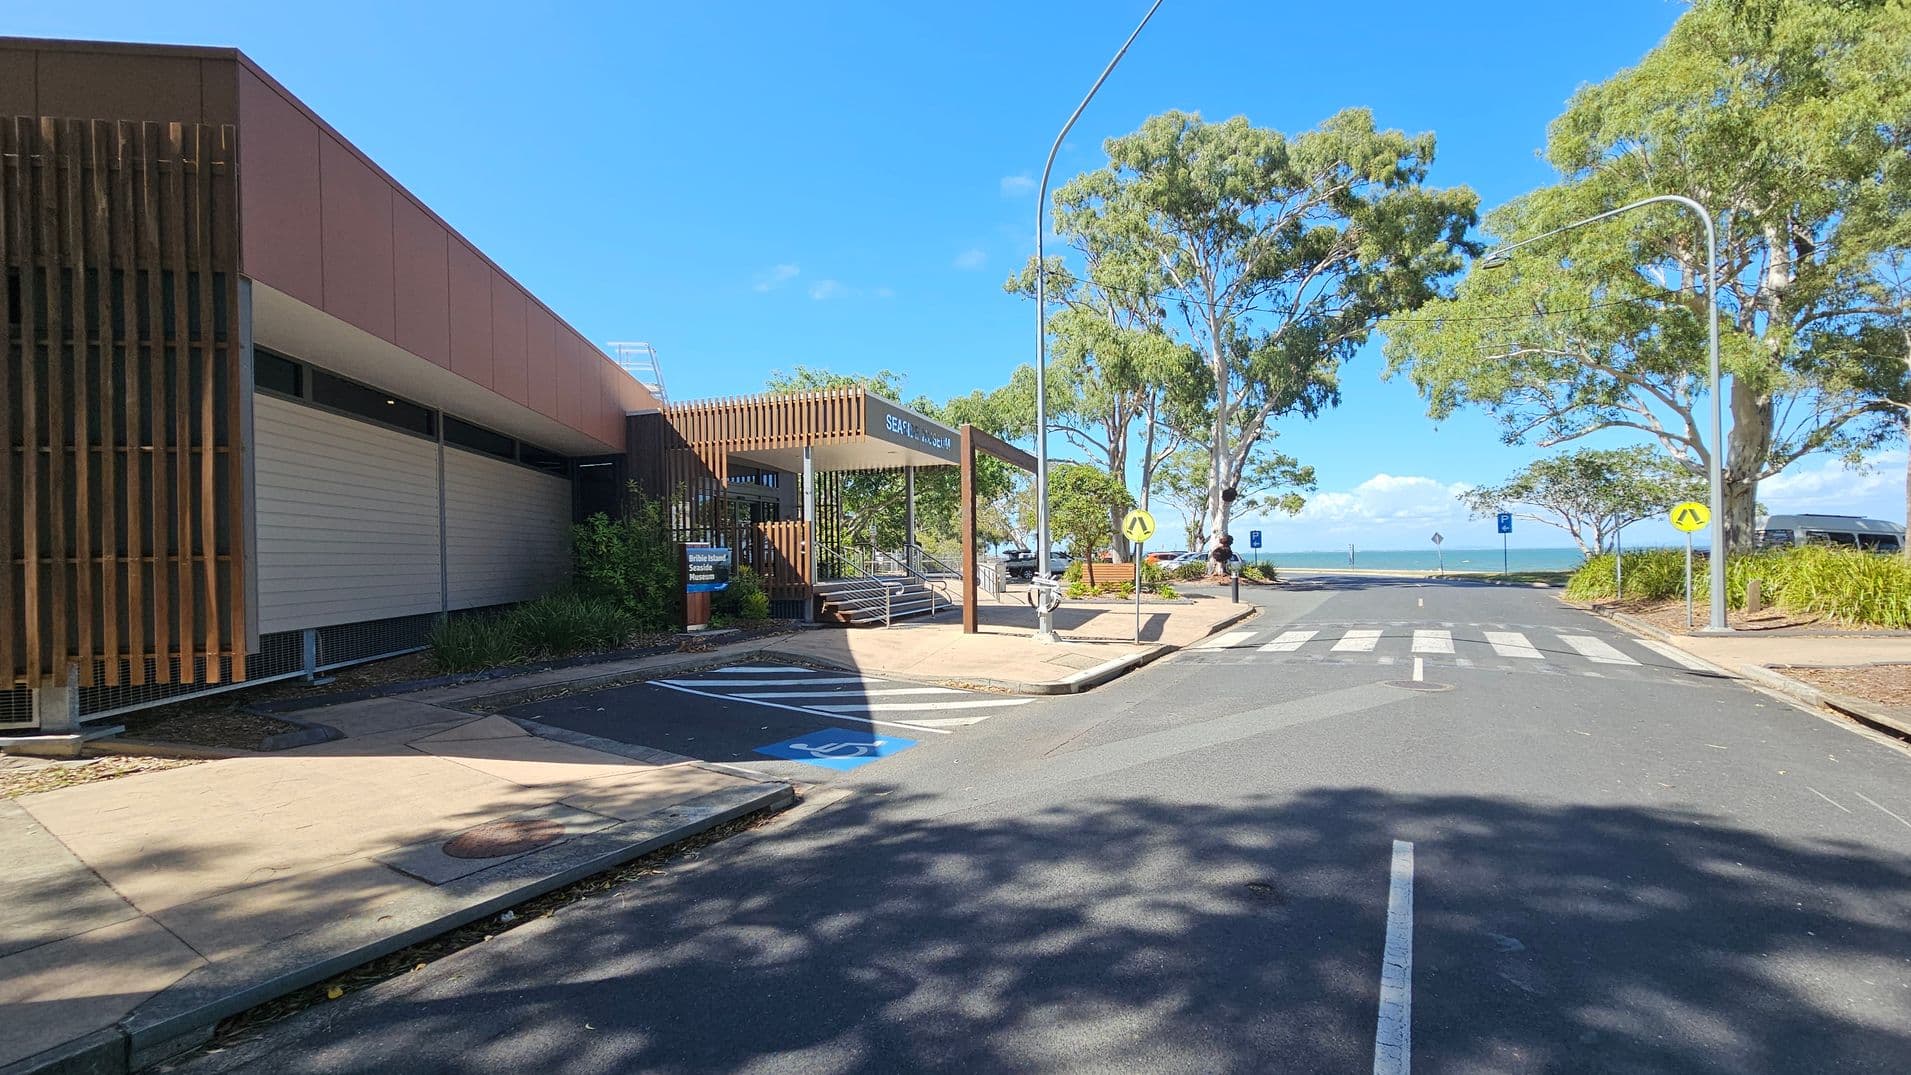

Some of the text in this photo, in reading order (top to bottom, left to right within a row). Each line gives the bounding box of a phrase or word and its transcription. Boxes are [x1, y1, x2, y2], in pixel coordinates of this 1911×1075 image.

[1501, 515, 1509, 523] P
[1252, 532, 1259, 540] P
[688, 554, 727, 562] Bribie Island
[688, 564, 713, 572] Seaside
[689, 573, 715, 581] Museum
